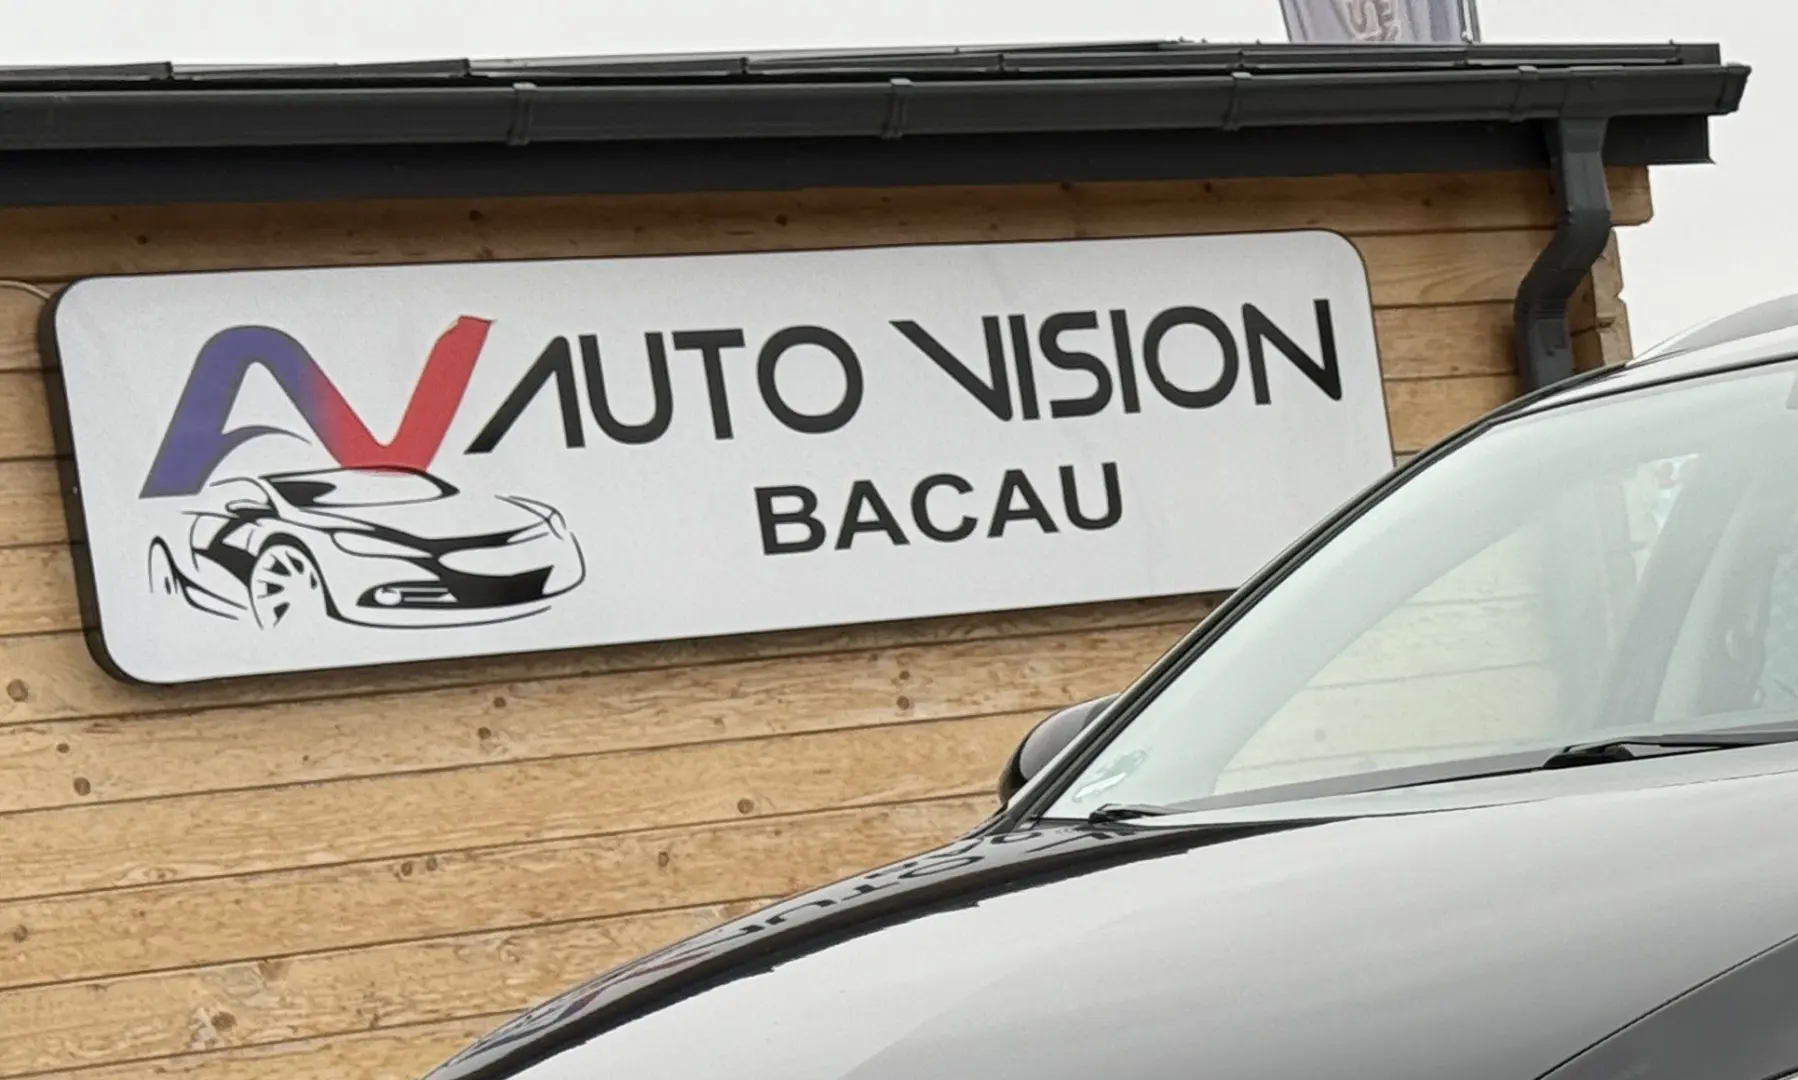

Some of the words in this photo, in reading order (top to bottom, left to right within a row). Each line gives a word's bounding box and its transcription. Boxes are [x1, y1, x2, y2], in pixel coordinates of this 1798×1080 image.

[465, 326, 864, 455] AUTO
[890, 298, 1343, 422] VISION
[755, 462, 1123, 556] BACAU
